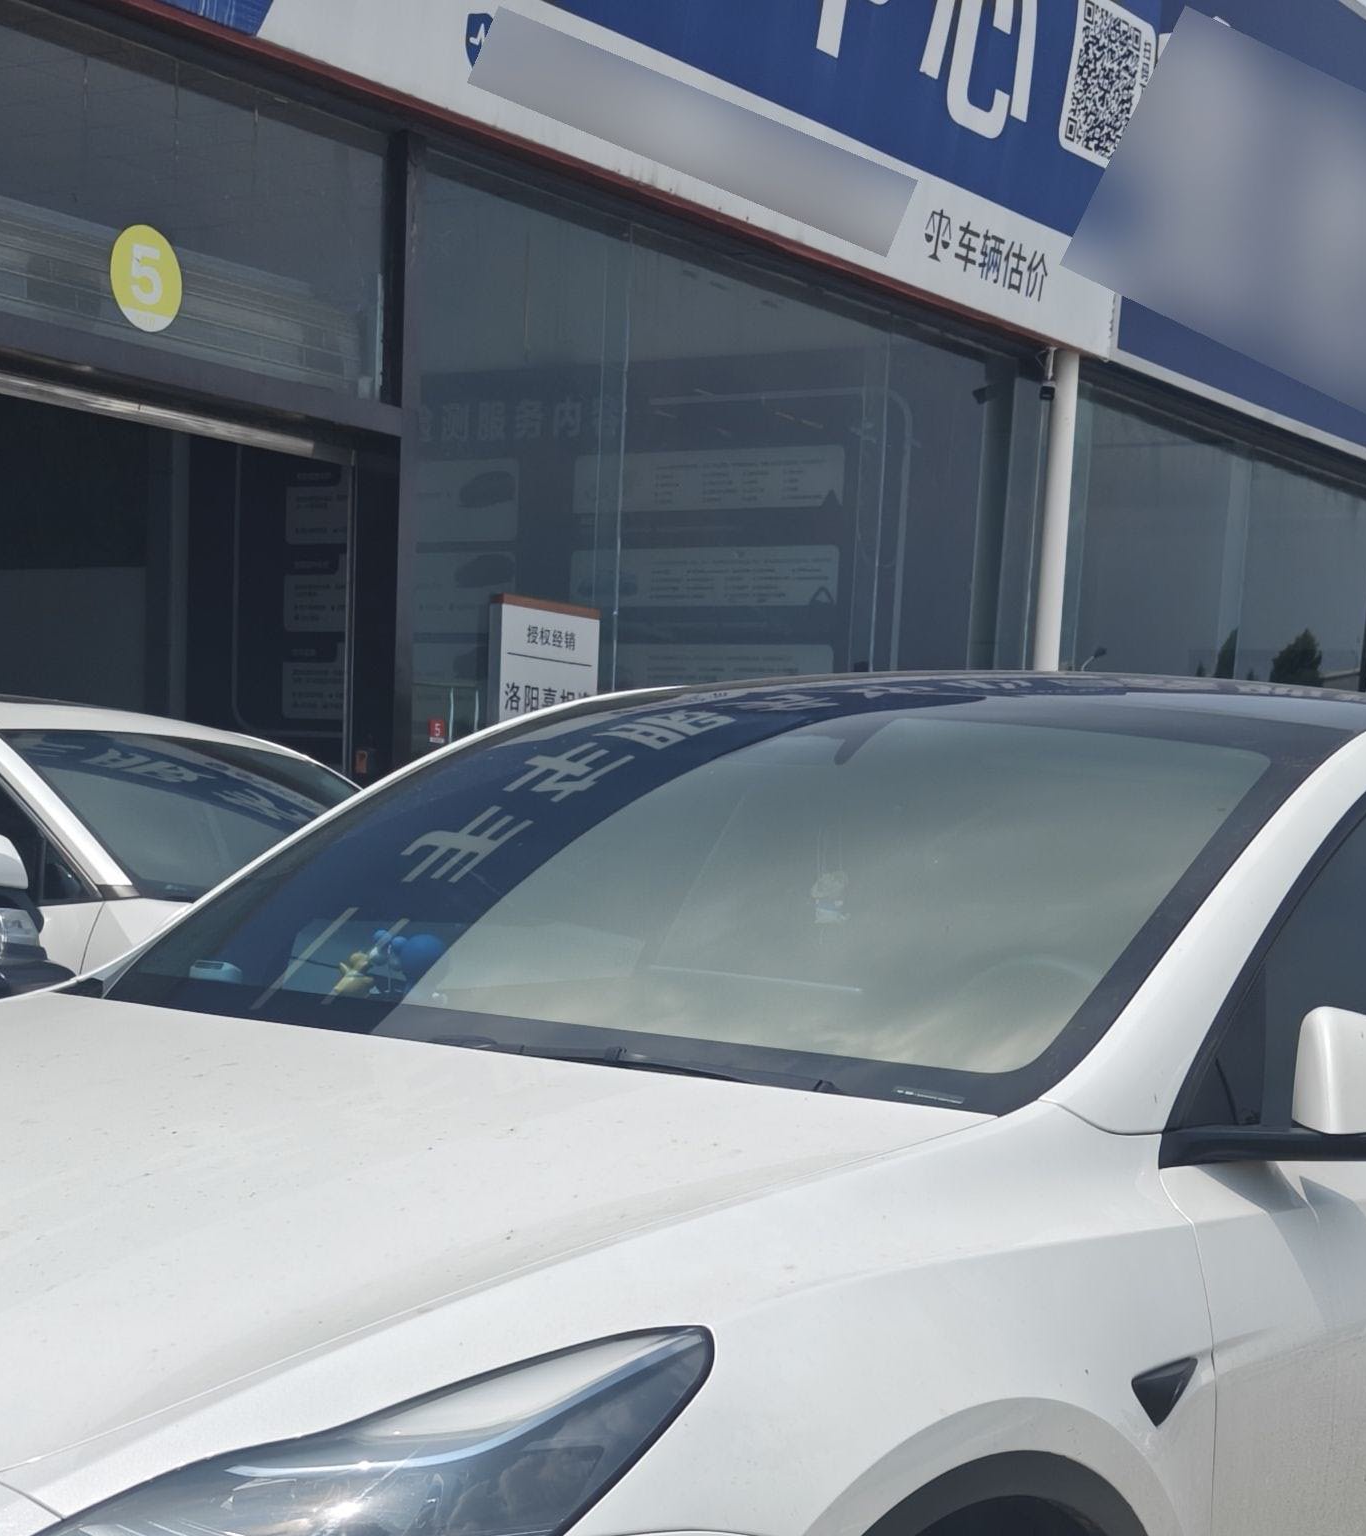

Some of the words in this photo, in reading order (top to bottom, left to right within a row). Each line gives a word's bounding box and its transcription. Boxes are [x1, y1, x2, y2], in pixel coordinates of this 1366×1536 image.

[130, 243, 163, 305] 5
[954, 221, 1049, 302] 车辆估价
[526, 624, 577, 651] 授权经销
[504, 682, 592, 714] 洛阳喜
